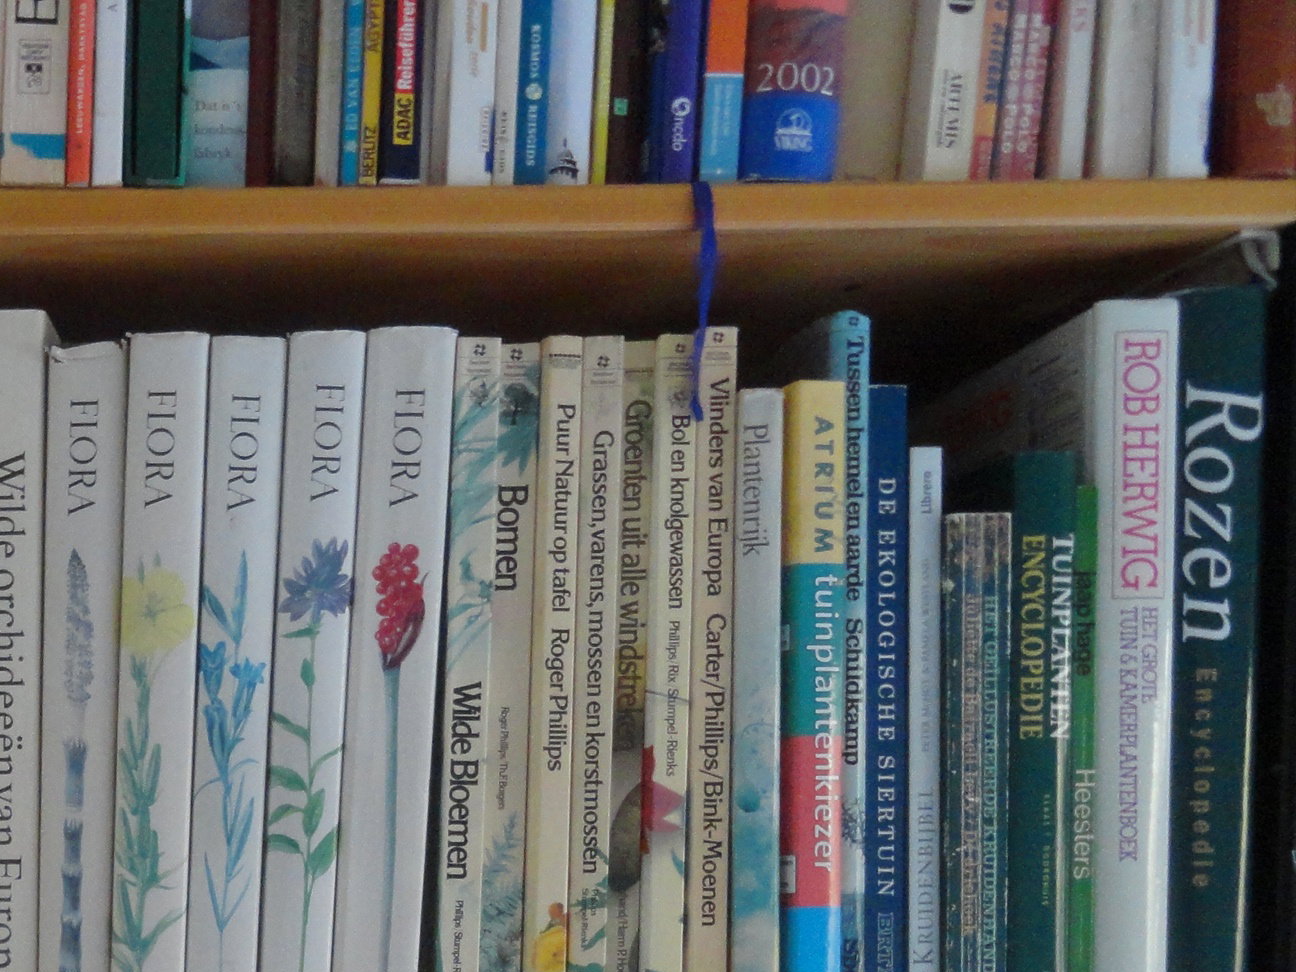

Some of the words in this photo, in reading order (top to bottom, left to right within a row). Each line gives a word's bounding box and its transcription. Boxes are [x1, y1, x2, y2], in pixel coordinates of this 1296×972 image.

[396, 98, 412, 140] ADAC
[757, 63, 835, 96] 2002
[708, 378, 731, 468] Vlinders
[1124, 338, 1161, 416] ROB
[67, 399, 100, 516] FLORA
[144, 389, 178, 509] FLORA
[227, 394, 261, 512] FLORA
[310, 384, 346, 504] FLORA
[389, 389, 427, 508] FLORA
[556, 404, 576, 453] Puur
[671, 415, 691, 446] Bol
[671, 450, 691, 473] en
[553, 460, 574, 537] Natuur
[707, 472, 730, 511] van
[738, 424, 770, 556] Plantenrijk
[814, 416, 835, 552] ATRIUM
[878, 478, 896, 515] DE
[1121, 423, 1159, 591] HERWIG
[1181, 379, 1265, 643] Rozen
[495, 485, 529, 592] Bomen
[548, 537, 568, 564] op
[667, 479, 690, 609] knolgewassen
[702, 518, 729, 596] Europa
[550, 567, 572, 611] tafel
[877, 531, 895, 740] EKOLOGISCHE
[1020, 534, 1045, 740] ENCYCLOPEDIE
[1051, 533, 1072, 739] TUINPLANTEN
[1120, 607, 1138, 650] TUIN
[1143, 607, 1159, 640] HET
[547, 629, 570, 691] Roger
[1120, 654, 1138, 665] &
[1141, 643, 1158, 704] GROTE
[452, 682, 482, 754] Wilde
[545, 696, 569, 771] Phillips
[807, 574, 840, 871] tuinplantenkiezer
[1119, 669, 1137, 862] KAMERPLANTENBOEK
[448, 759, 478, 880] Bloemen
[877, 756, 895, 896] SIERTUIN
[1073, 769, 1095, 879] Heesters
[1190, 667, 1217, 889] Encyclopedie
